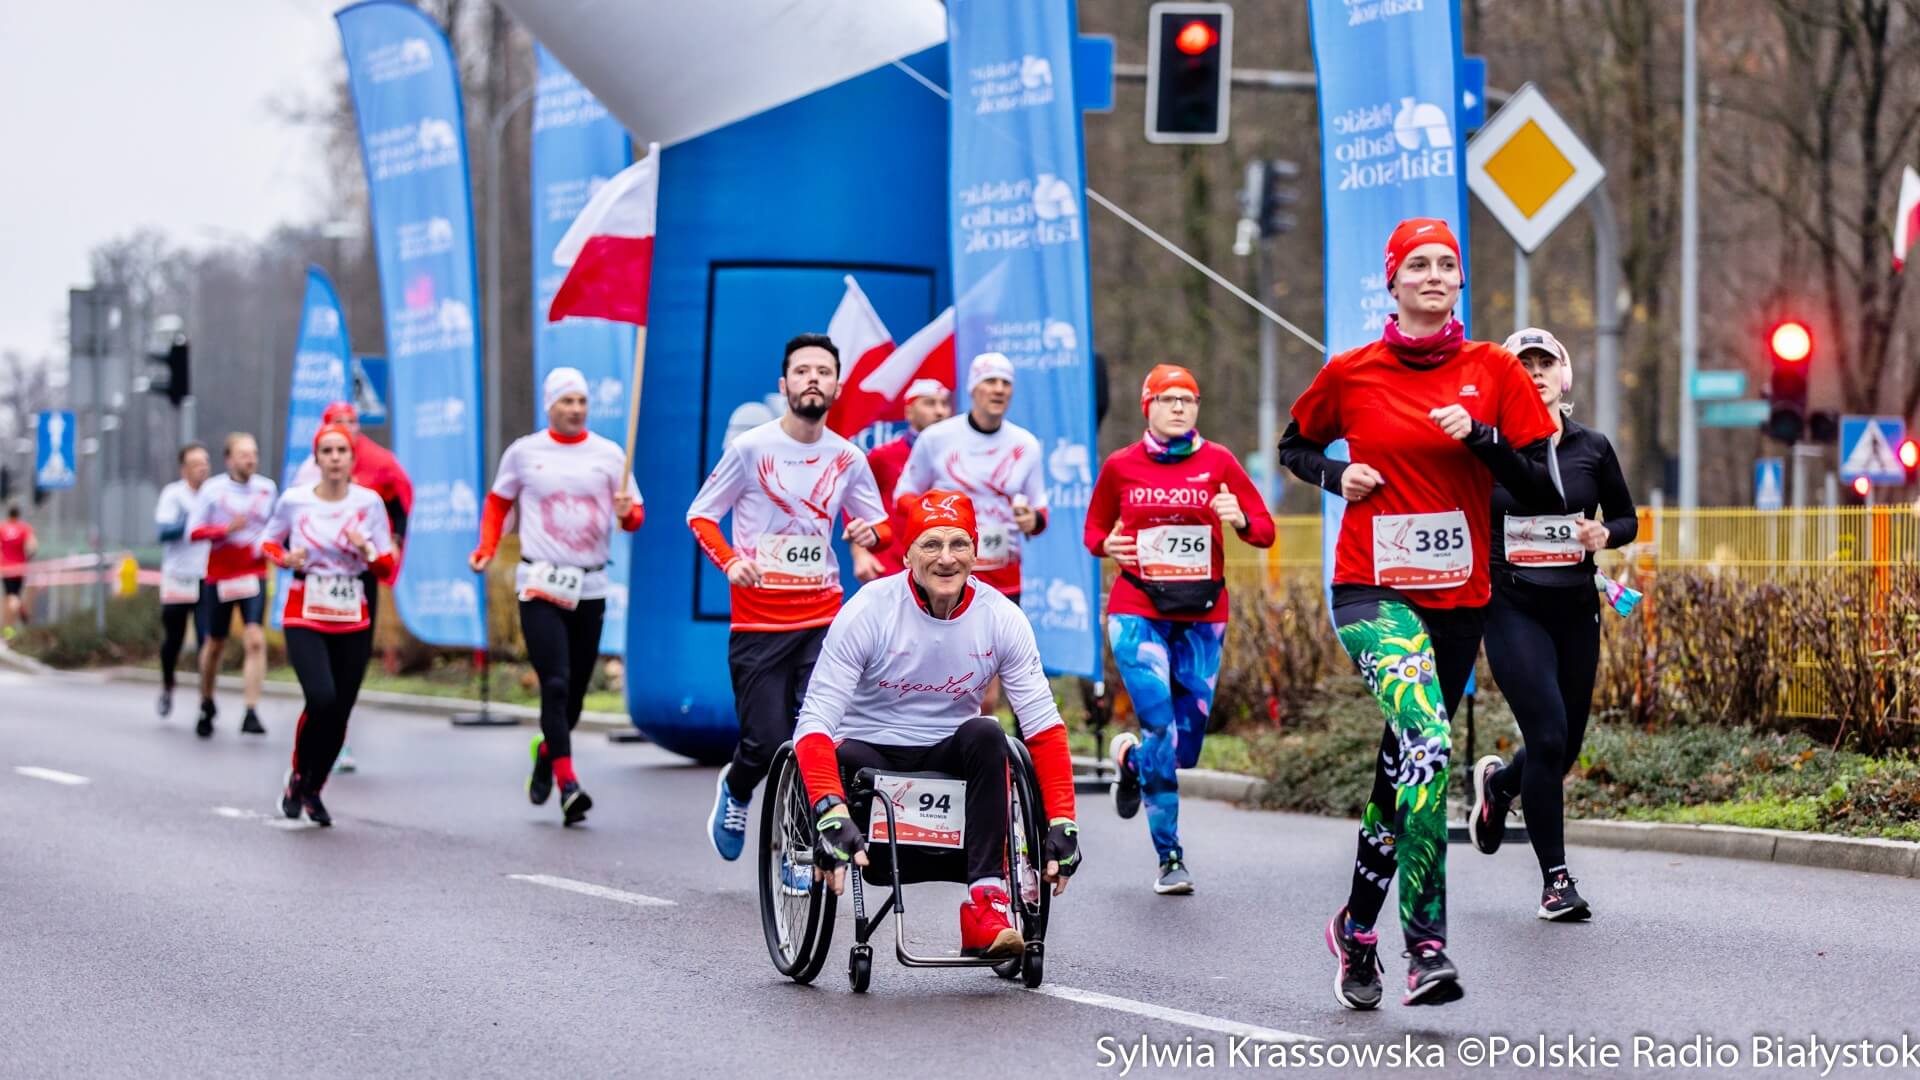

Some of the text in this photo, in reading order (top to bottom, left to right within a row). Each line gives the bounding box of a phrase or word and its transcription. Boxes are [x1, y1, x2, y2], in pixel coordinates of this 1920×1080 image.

[1129, 487, 1209, 505] 1919-2019
[1415, 526, 1464, 552] 385
[1544, 525, 1571, 541] 39
[1167, 537, 1205, 553] 756
[786, 546, 821, 562] 646
[919, 792, 951, 813] 94
